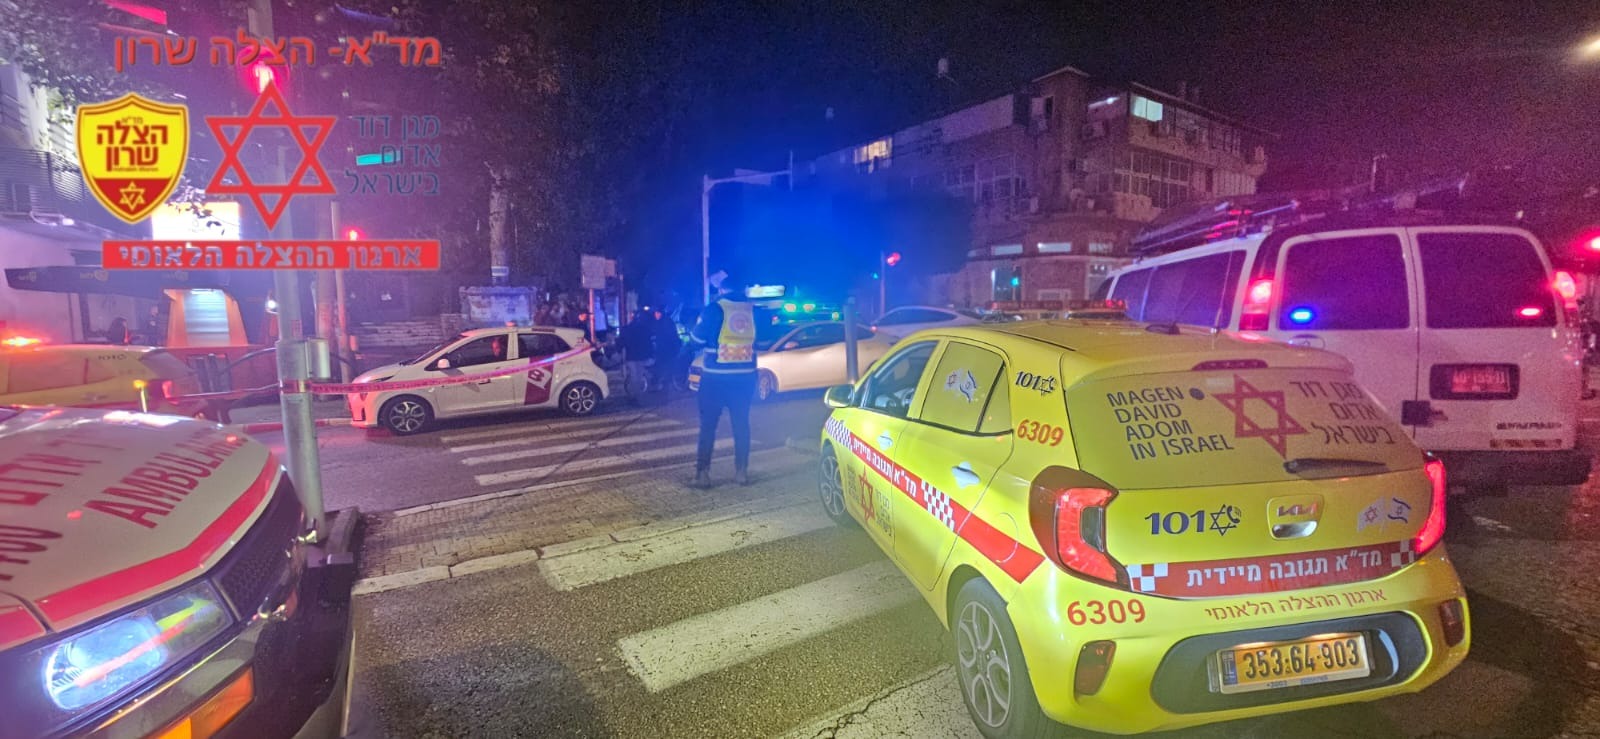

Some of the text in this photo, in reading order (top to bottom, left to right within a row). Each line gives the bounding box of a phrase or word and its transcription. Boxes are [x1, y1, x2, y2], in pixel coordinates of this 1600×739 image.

[1015, 371, 1041, 390] 101
[1289, 380, 1328, 398] דוד
[1107, 386, 1184, 407] MAGEN
[1114, 403, 1182, 423] DAVID
[1328, 402, 1384, 421] אדום
[1017, 418, 1065, 447] 6309
[1126, 419, 1193, 441] ADOM
[1311, 422, 1398, 445] בישראל
[1130, 434, 1235, 460] IN ISRAEL
[1277, 502, 1318, 517] KIA
[1145, 510, 1205, 535] 101
[1186, 549, 1382, 587] מד"א תגובה מיידית
[1067, 598, 1146, 626] 6309
[1204, 589, 1387, 621] ארגון ההצלה הלאומי
